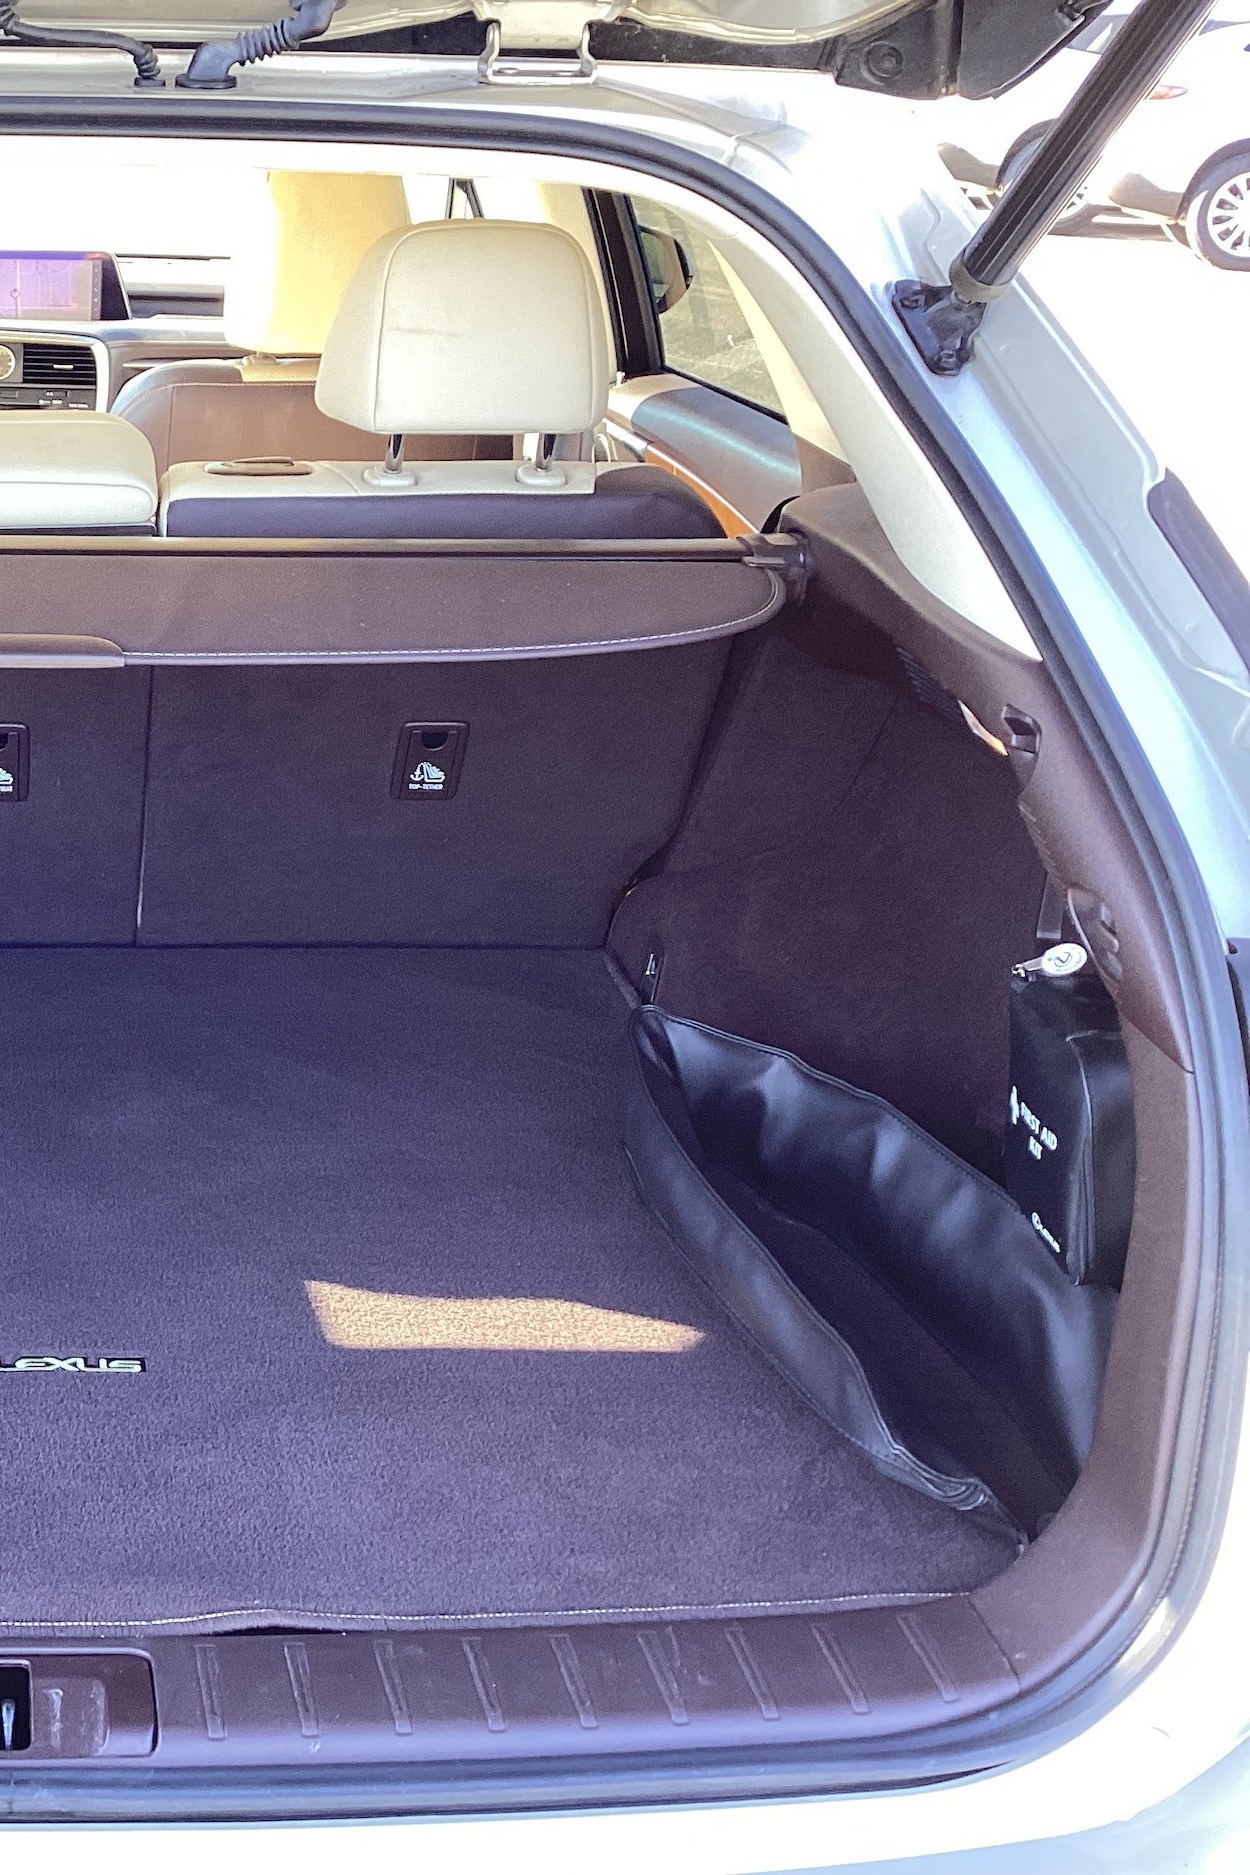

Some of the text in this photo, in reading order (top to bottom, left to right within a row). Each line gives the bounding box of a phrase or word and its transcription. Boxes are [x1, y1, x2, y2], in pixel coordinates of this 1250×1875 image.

[1020, 1101, 1058, 1151] FIRST AID
[1029, 1135, 1043, 1160] KIT
